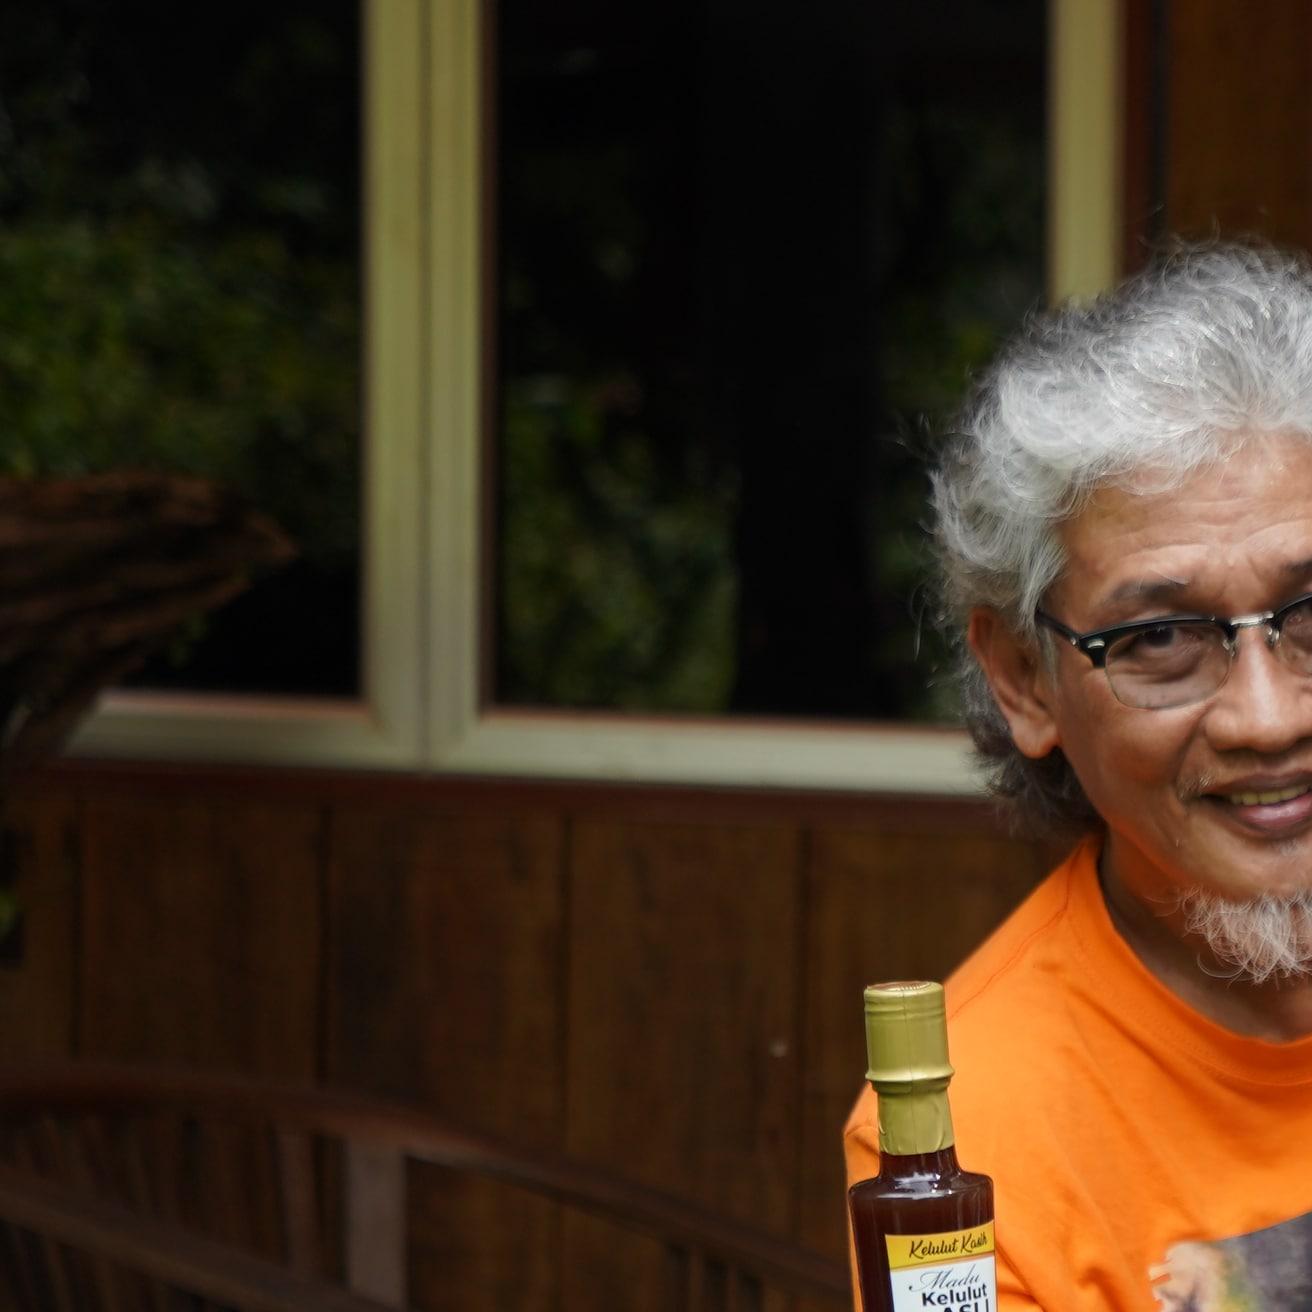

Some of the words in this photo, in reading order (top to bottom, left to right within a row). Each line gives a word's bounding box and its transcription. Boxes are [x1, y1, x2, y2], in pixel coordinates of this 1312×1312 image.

[908, 1239, 959, 1259] Kelulut
[960, 1231, 988, 1254] Kasih
[909, 1264, 981, 1292] Madu
[922, 1284, 988, 1306] Kelulut
